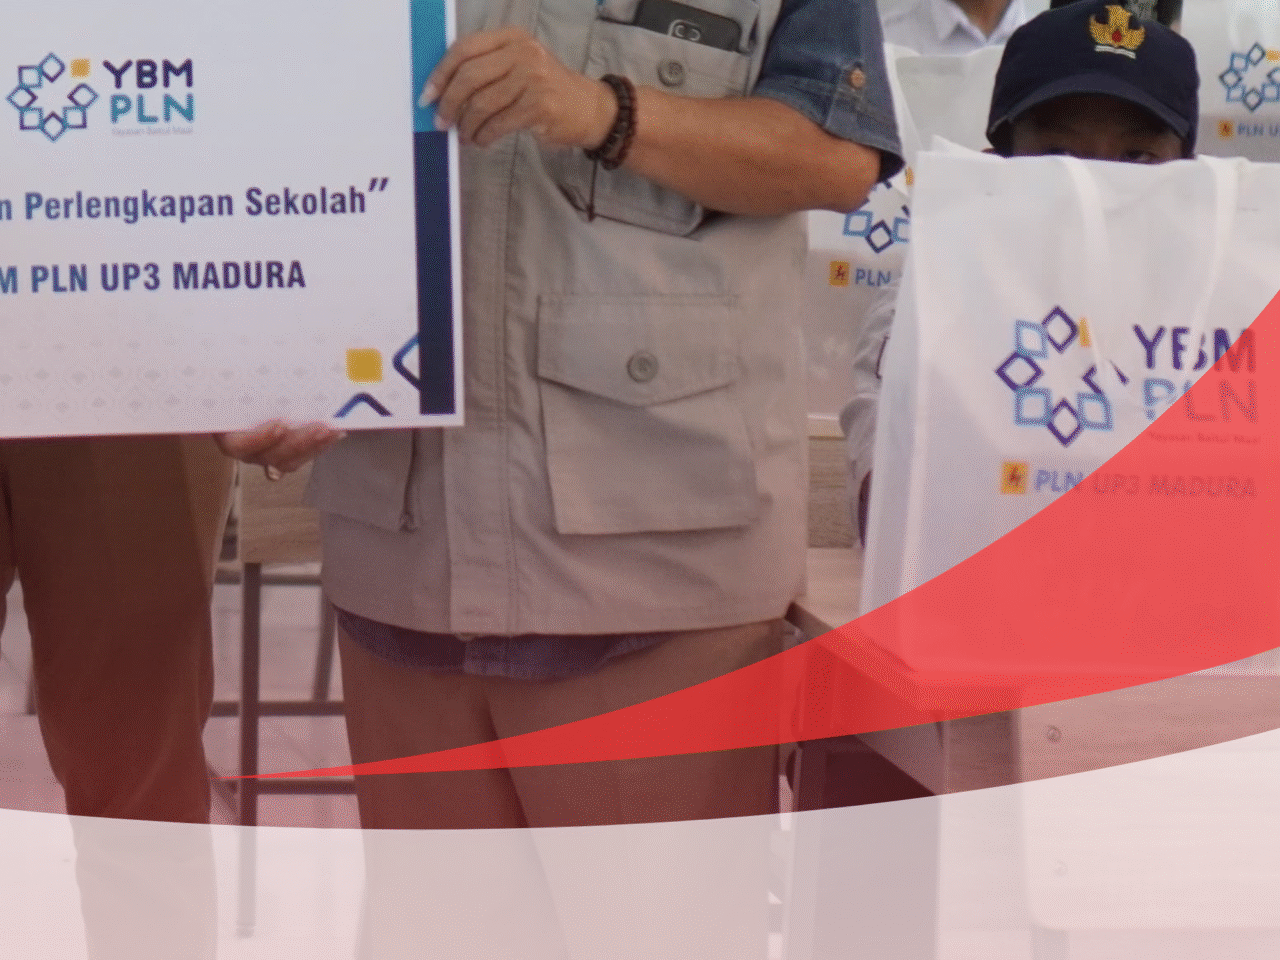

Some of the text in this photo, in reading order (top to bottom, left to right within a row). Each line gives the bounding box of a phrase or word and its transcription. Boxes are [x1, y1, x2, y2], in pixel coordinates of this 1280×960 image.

[102, 59, 194, 89] YBM
[110, 93, 195, 124] PLN
[24, 189, 234, 224] Perlengkapan
[30, 264, 88, 293] PLN
[100, 263, 161, 291] UP3
[172, 260, 307, 290] MADURA
[854, 267, 891, 287] PLN
[1142, 377, 1259, 424] PLN
[1034, 469, 1257, 498] PLN UP3 MADURA
